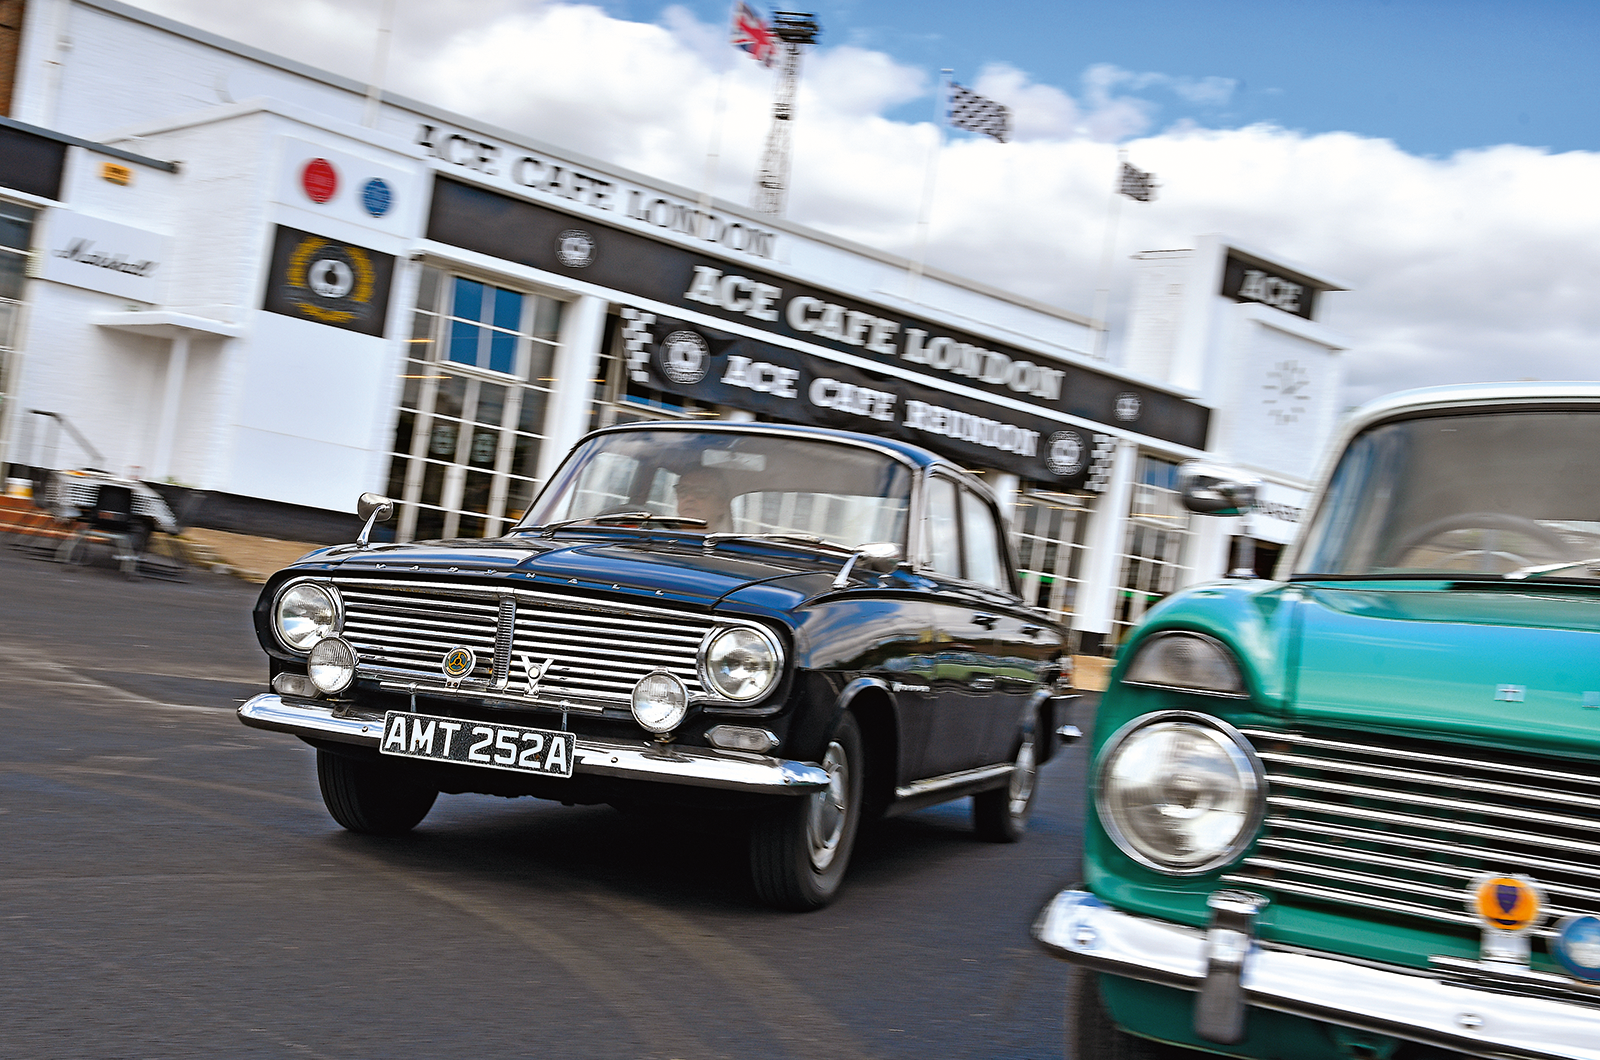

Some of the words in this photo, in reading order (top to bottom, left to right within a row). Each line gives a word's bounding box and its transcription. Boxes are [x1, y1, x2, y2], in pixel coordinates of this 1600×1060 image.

[415, 123, 499, 175] ACE
[512, 157, 613, 210] CAFE
[626, 190, 776, 258] LONDON
[1238, 269, 1303, 312] ACE
[684, 265, 782, 322] ACE
[786, 295, 897, 354] CAFE
[902, 328, 1065, 399] LONDON
[720, 356, 799, 398] ACE
[808, 378, 897, 421] CAFE
[384, 717, 462, 757] AMT
[468, 727, 567, 772] 252A
